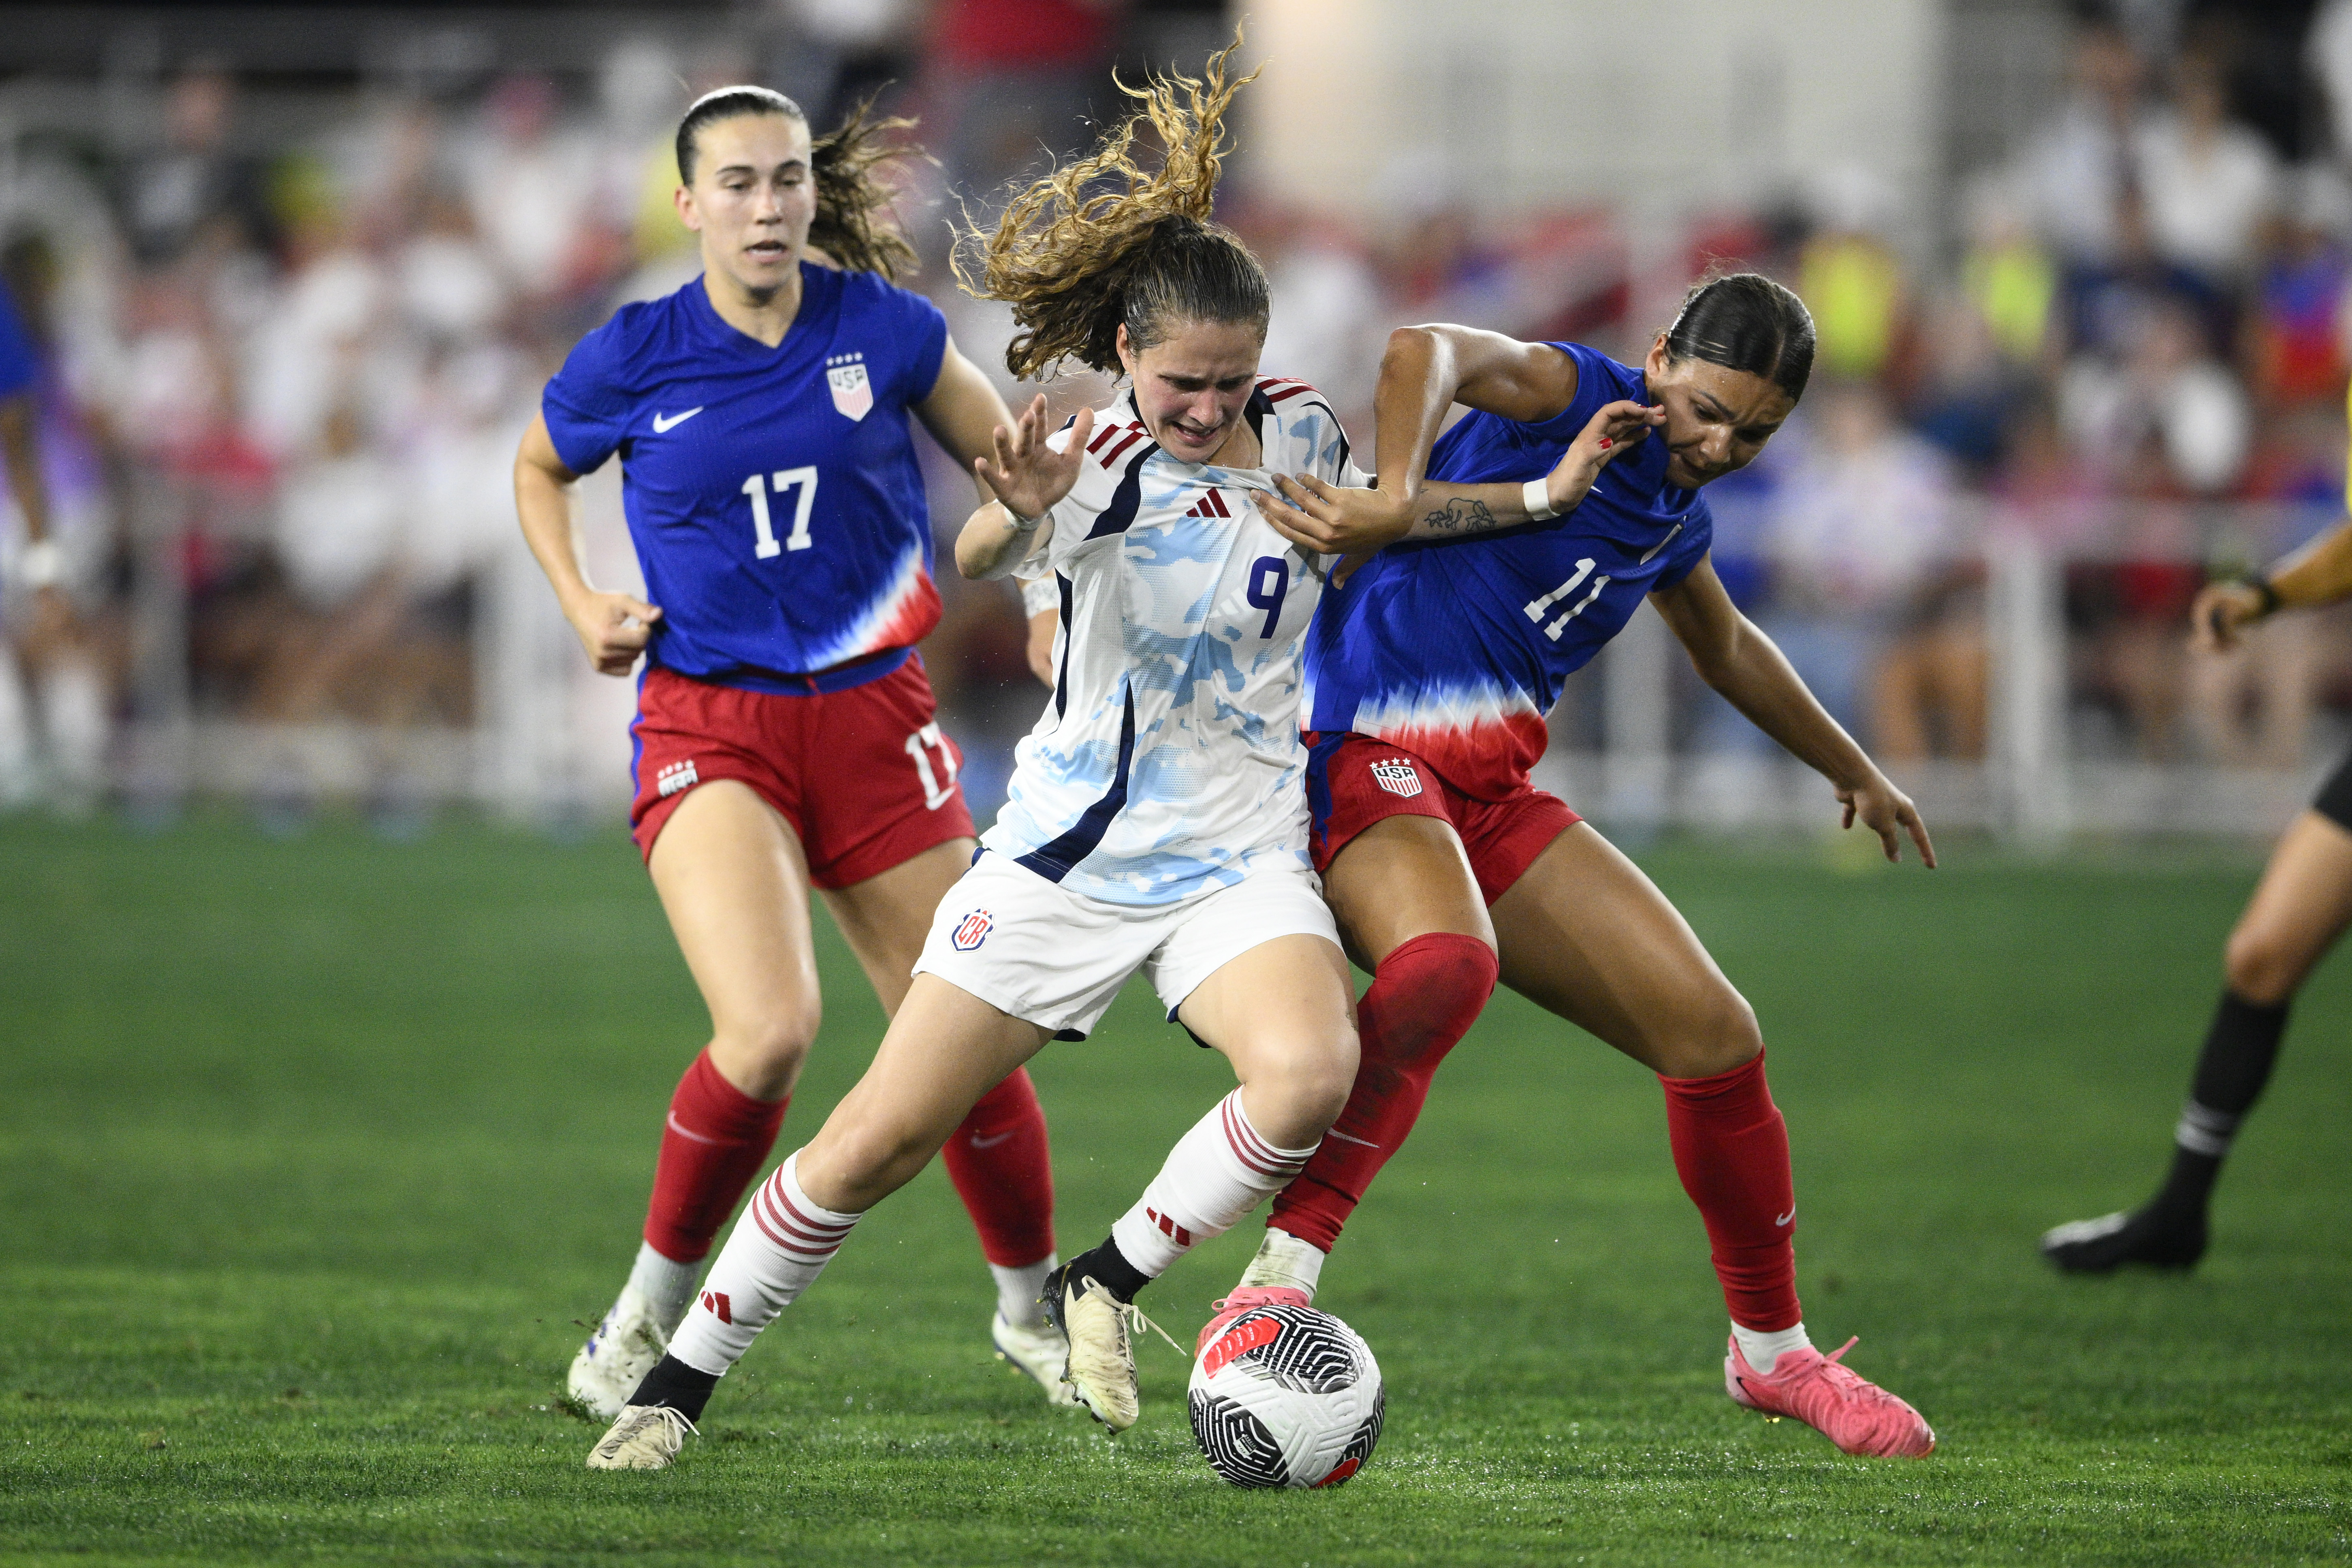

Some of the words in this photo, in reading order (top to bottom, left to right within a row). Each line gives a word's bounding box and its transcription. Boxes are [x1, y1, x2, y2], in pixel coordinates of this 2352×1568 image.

[742, 465, 818, 559] 17
[1247, 556, 1289, 639] 9
[1523, 558, 1611, 642] 11
[1376, 768, 1414, 779] USA
